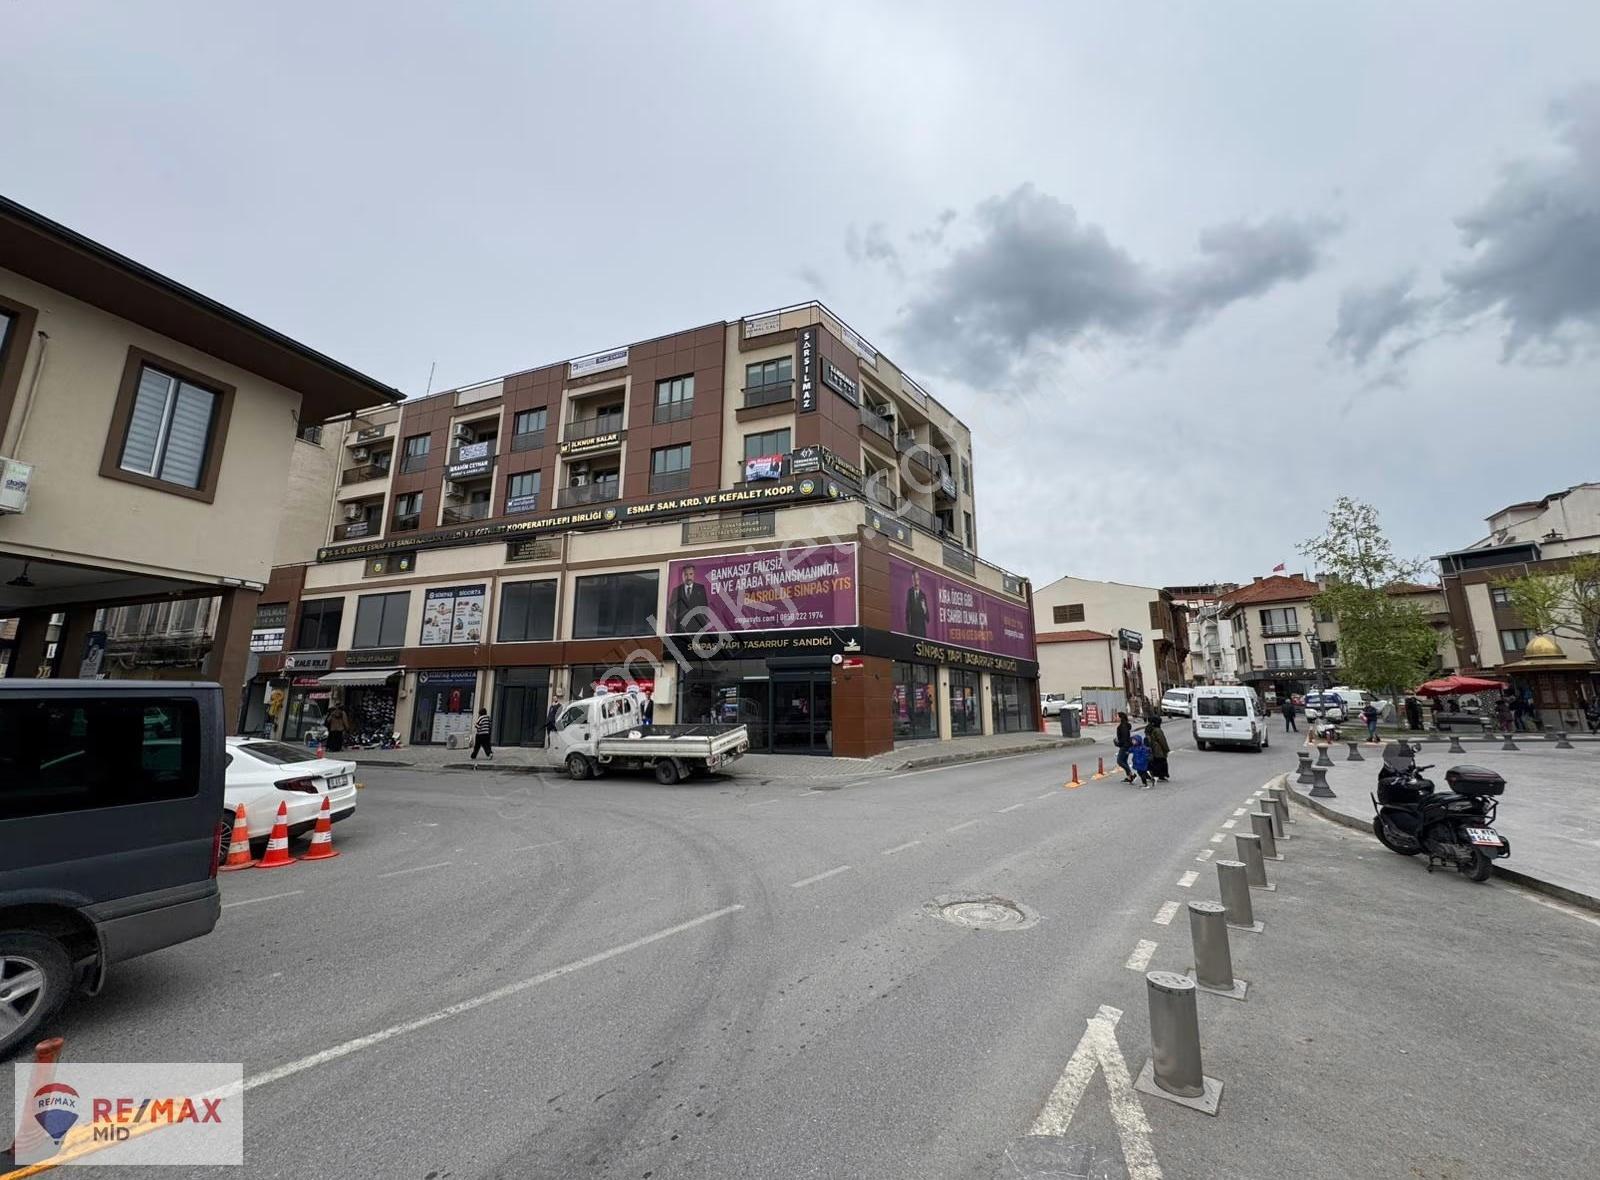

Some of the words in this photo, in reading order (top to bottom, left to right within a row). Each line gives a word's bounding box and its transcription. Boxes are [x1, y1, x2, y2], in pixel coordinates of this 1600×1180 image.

[802, 332, 811, 408] SARSILMAZ
[627, 504, 655, 515] ESNAF
[657, 499, 678, 510] SAN.
[680, 497, 702, 508] KRD.
[704, 495, 717, 505] VE
[718, 489, 763, 503] KEFALET
[764, 485, 795, 496] KOOP.
[571, 510, 602, 523] BİRLİĞİ
[711, 562, 751, 581] BANKASIZ
[752, 556, 783, 574] FAİZSİZ
[711, 582, 721, 595] EV
[723, 580, 734, 593] VE
[735, 577, 764, 591] ARABA
[765, 562, 840, 587] FİNANSMANINDA
[831, 577, 851, 591] YTS
[808, 611, 824, 620] 1974
[720, 641, 740, 650] YAPI
[743, 639, 789, 649] TASARRUF
[792, 635, 832, 647] SANDIĞI
[915, 640, 945, 663] SİNPAŞ
